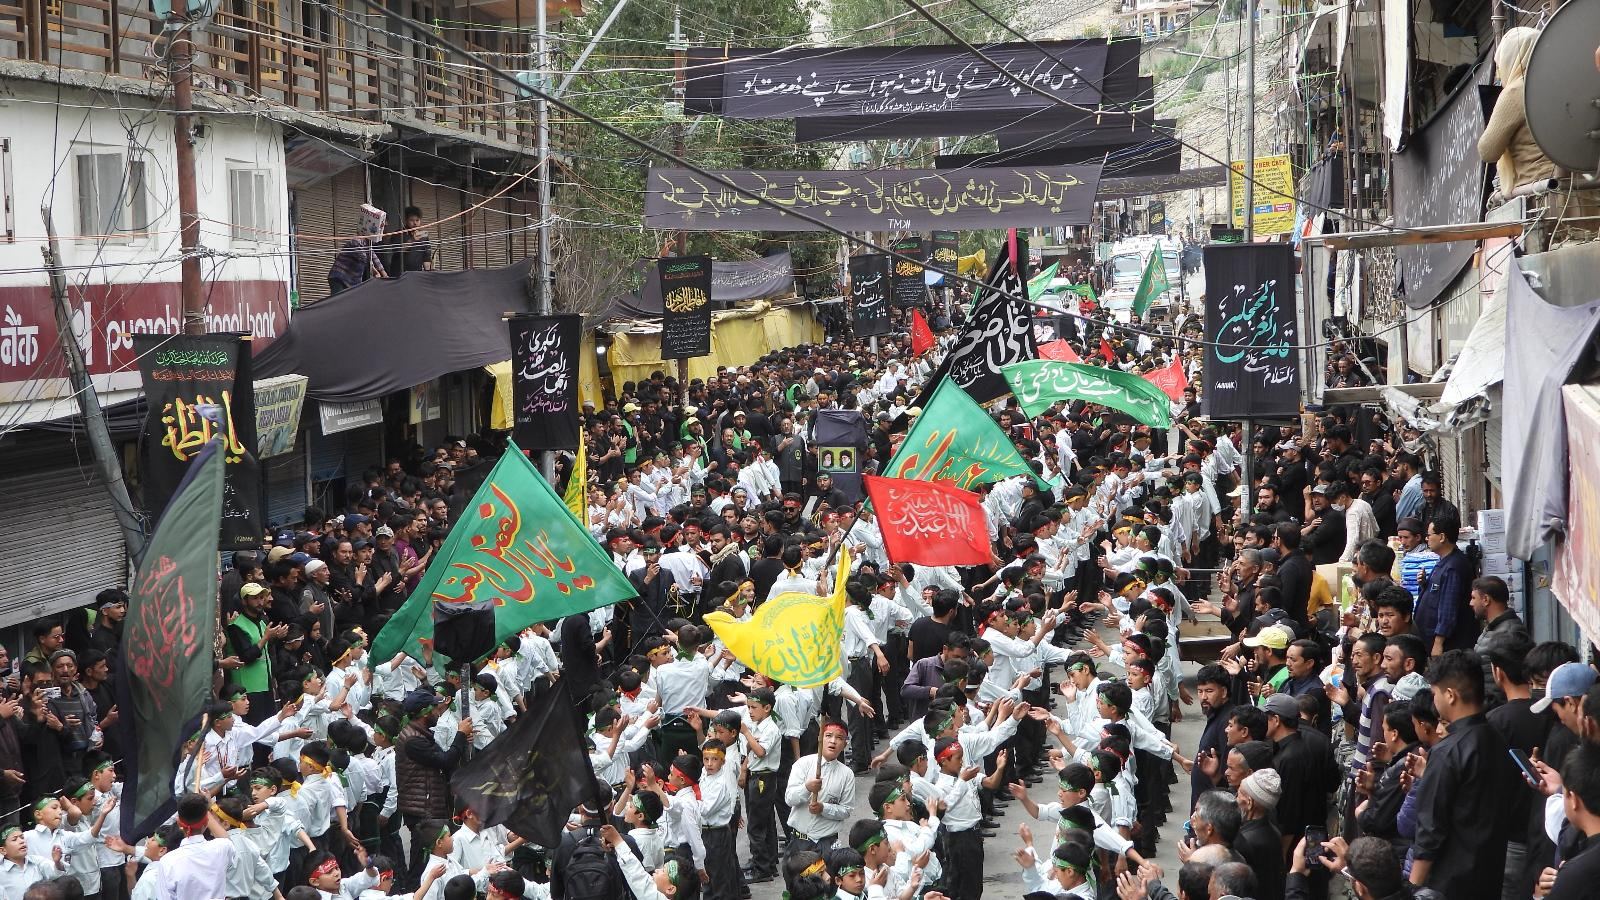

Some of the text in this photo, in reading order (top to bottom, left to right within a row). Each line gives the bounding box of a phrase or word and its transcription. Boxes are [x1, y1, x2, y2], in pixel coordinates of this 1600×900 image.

[801, 71, 842, 107] اپنے
[902, 69, 947, 95] طاقت
[247, 300, 276, 339] bank
